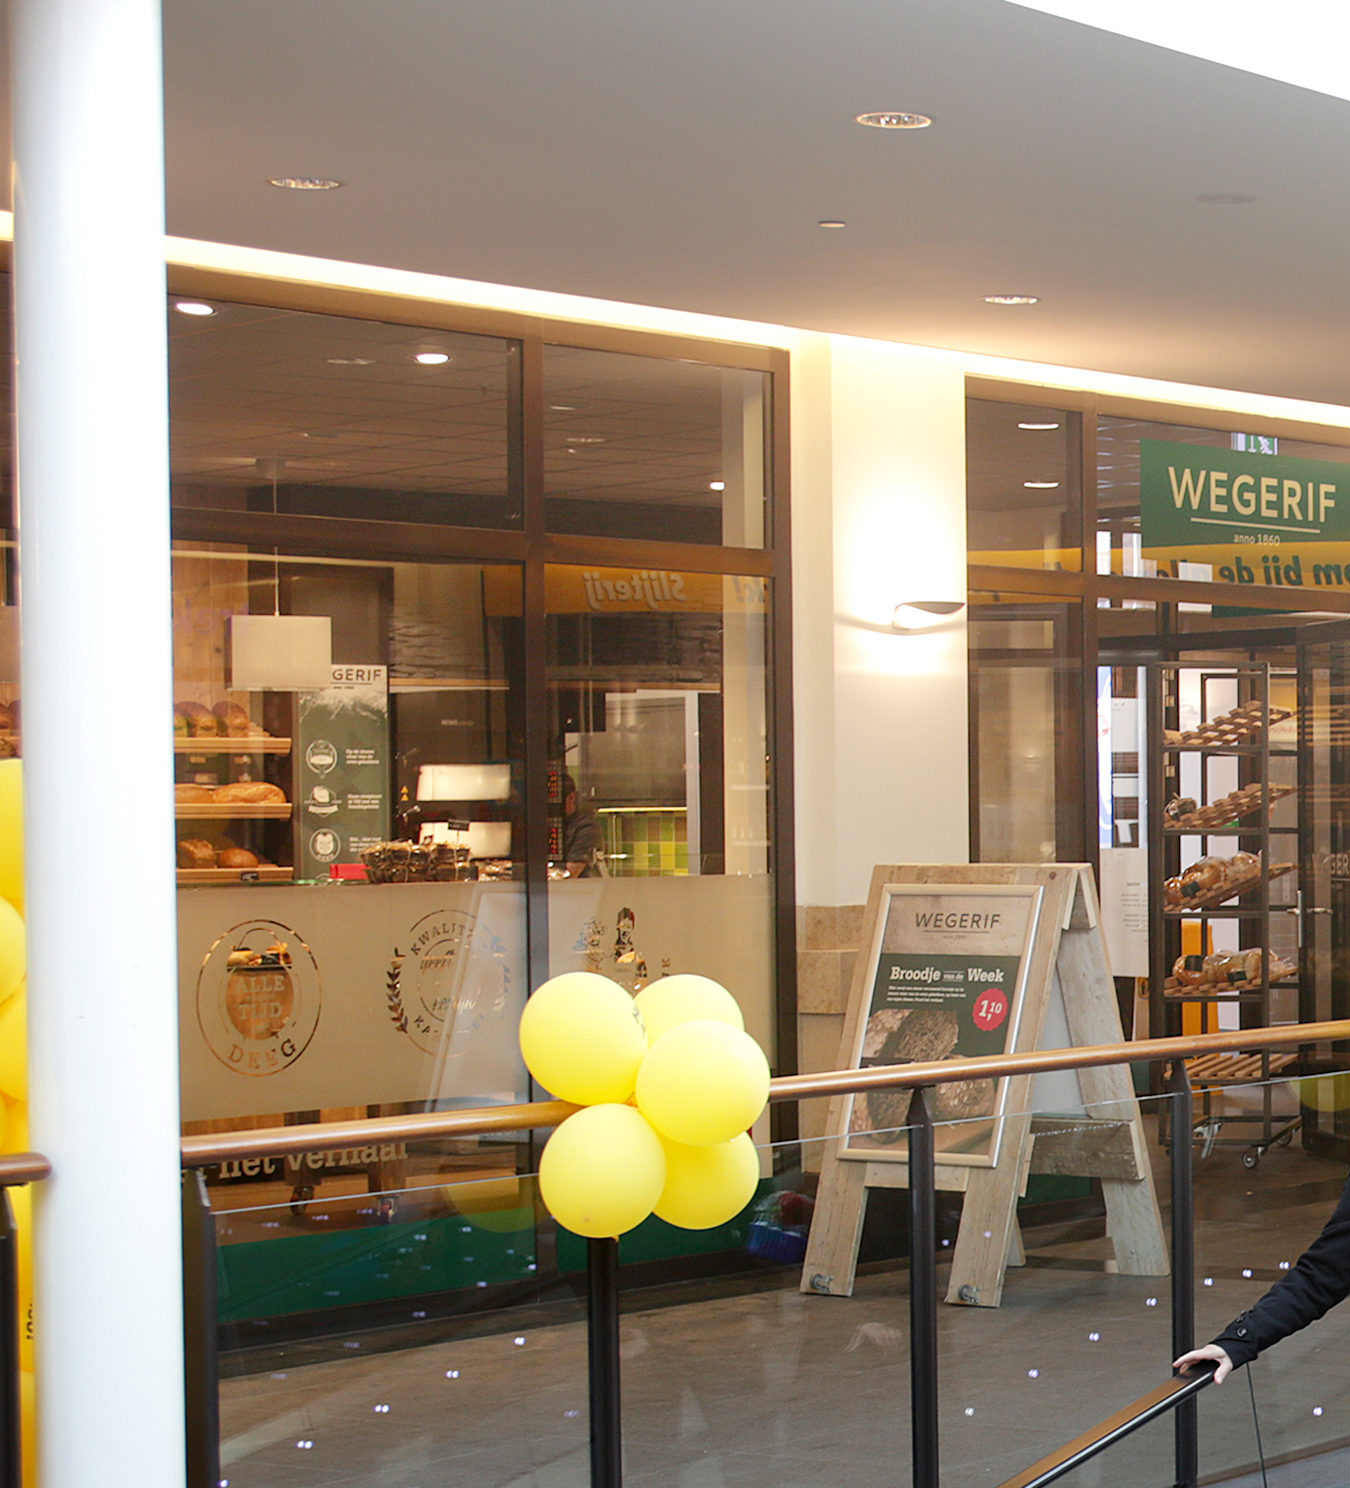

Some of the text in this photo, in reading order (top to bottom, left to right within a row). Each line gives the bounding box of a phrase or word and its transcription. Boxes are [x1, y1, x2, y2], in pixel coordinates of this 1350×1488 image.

[1168, 466, 1336, 523] WEGERIF
[1234, 534, 1280, 546] anno 1860
[332, 668, 382, 681] GERIF
[915, 912, 1001, 929] WEGERIF
[889, 966, 941, 983] Broodje
[967, 967, 1005, 982] Week
[236, 975, 285, 992] ALLE
[978, 999, 1003, 1021] 1,10
[227, 1038, 297, 1069] DEEG
